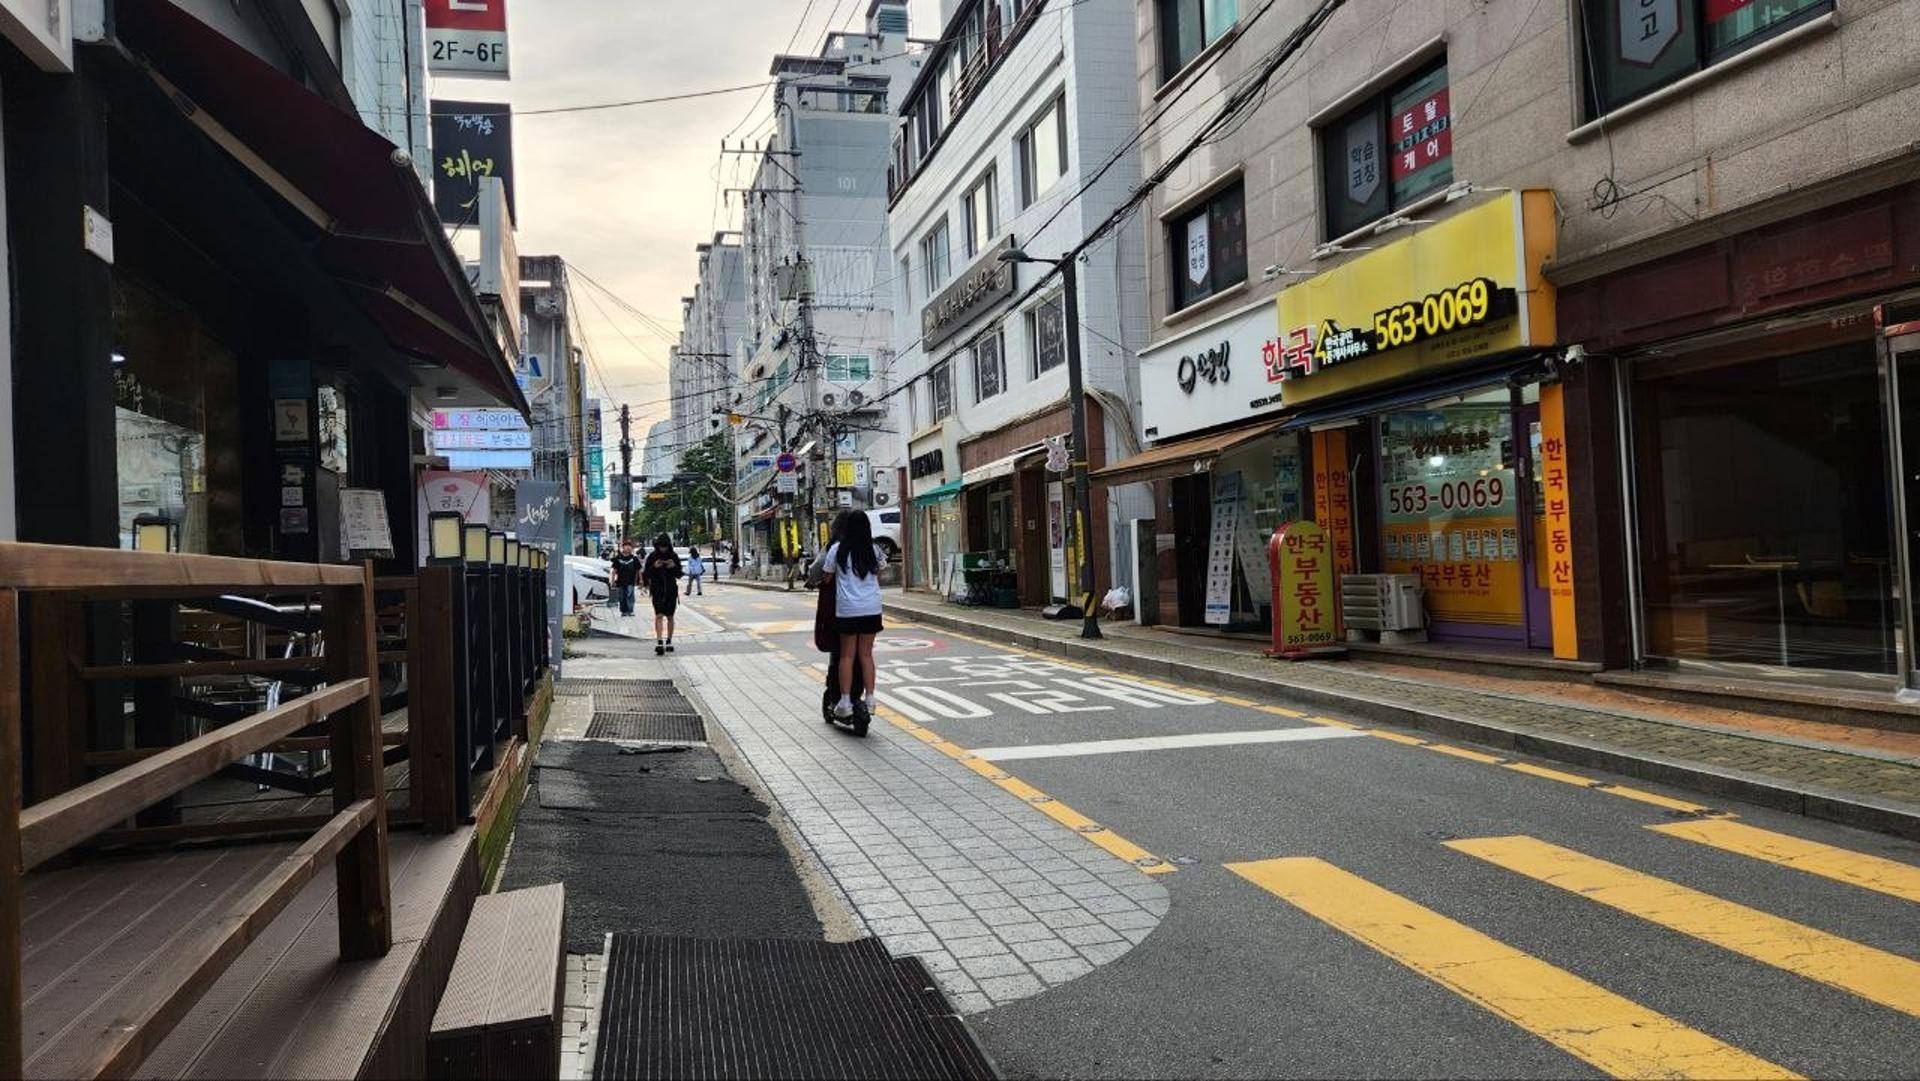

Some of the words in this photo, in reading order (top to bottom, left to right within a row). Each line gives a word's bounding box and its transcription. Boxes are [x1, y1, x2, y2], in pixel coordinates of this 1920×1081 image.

[433, 40, 503, 62] 2F~6F
[441, 149, 493, 186] 헤어
[1404, 138, 1438, 169] 케어
[838, 177, 856, 190] 101
[1375, 279, 1488, 350] 563-0069
[1262, 327, 1313, 384] 한국
[1390, 478, 1503, 514] 563-0069
[1545, 438, 1570, 583] 한국부동산
[1286, 534, 1326, 554] 한국
[1411, 563, 1491, 588] 한국부동산
[1293, 557, 1323, 632] 부동산
[1288, 633, 1331, 644] 563-0069
